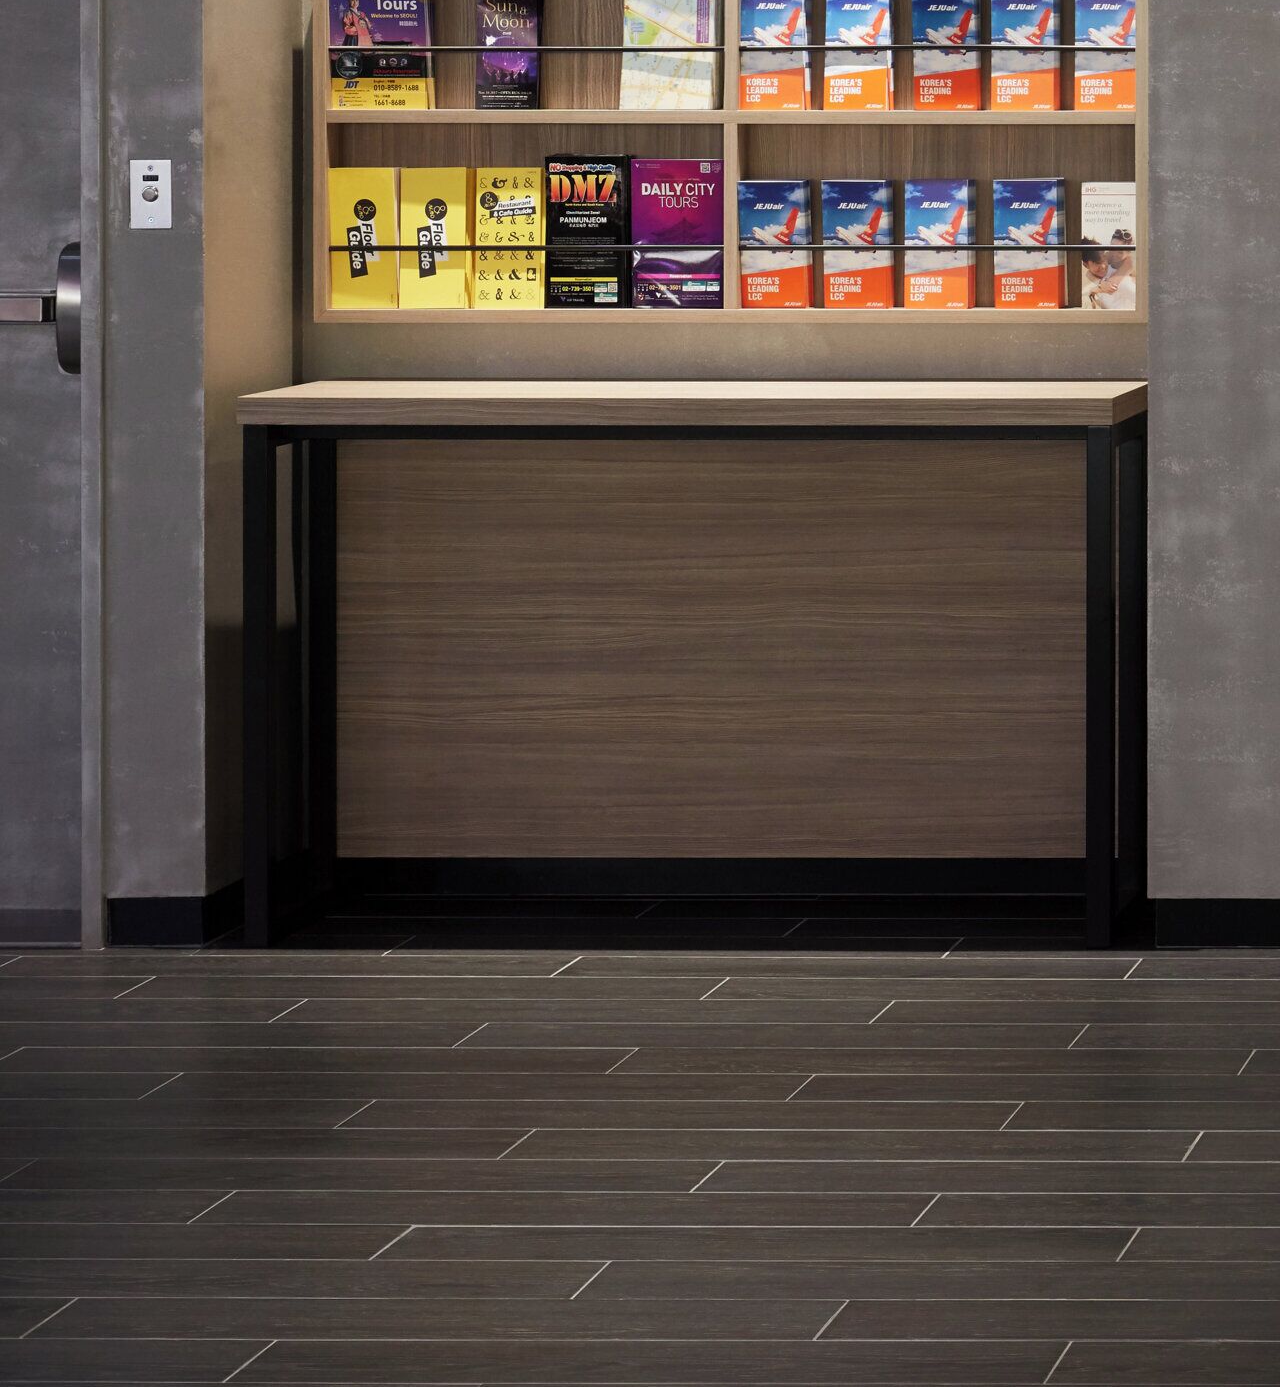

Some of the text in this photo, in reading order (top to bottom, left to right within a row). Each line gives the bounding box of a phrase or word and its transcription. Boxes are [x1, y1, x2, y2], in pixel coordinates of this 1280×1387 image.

[482, 13, 530, 31] Moon
[344, 81, 359, 89] JDT
[746, 78, 778, 86] KOREA'S
[920, 79, 952, 87] KOREA'S
[830, 87, 862, 95] LEADING
[920, 87, 952, 95] LEADING
[997, 87, 1029, 95] LEADING
[1081, 87, 1112, 95] LEADING
[1081, 95, 1095, 103] LCC
[549, 174, 617, 203] DMZ
[642, 183, 715, 196] DAILY CITY
[498, 200, 531, 208] Restaurant
[659, 196, 698, 208] TOURS
[748, 277, 779, 285] KOREA'S
[830, 277, 862, 285] KOREA'S
[748, 285, 779, 293] LEADING
[830, 285, 861, 293] LEADING
[910, 285, 942, 293] LEADING
[1001, 285, 1033, 293] LEADING
[910, 293, 925, 301] LCC
